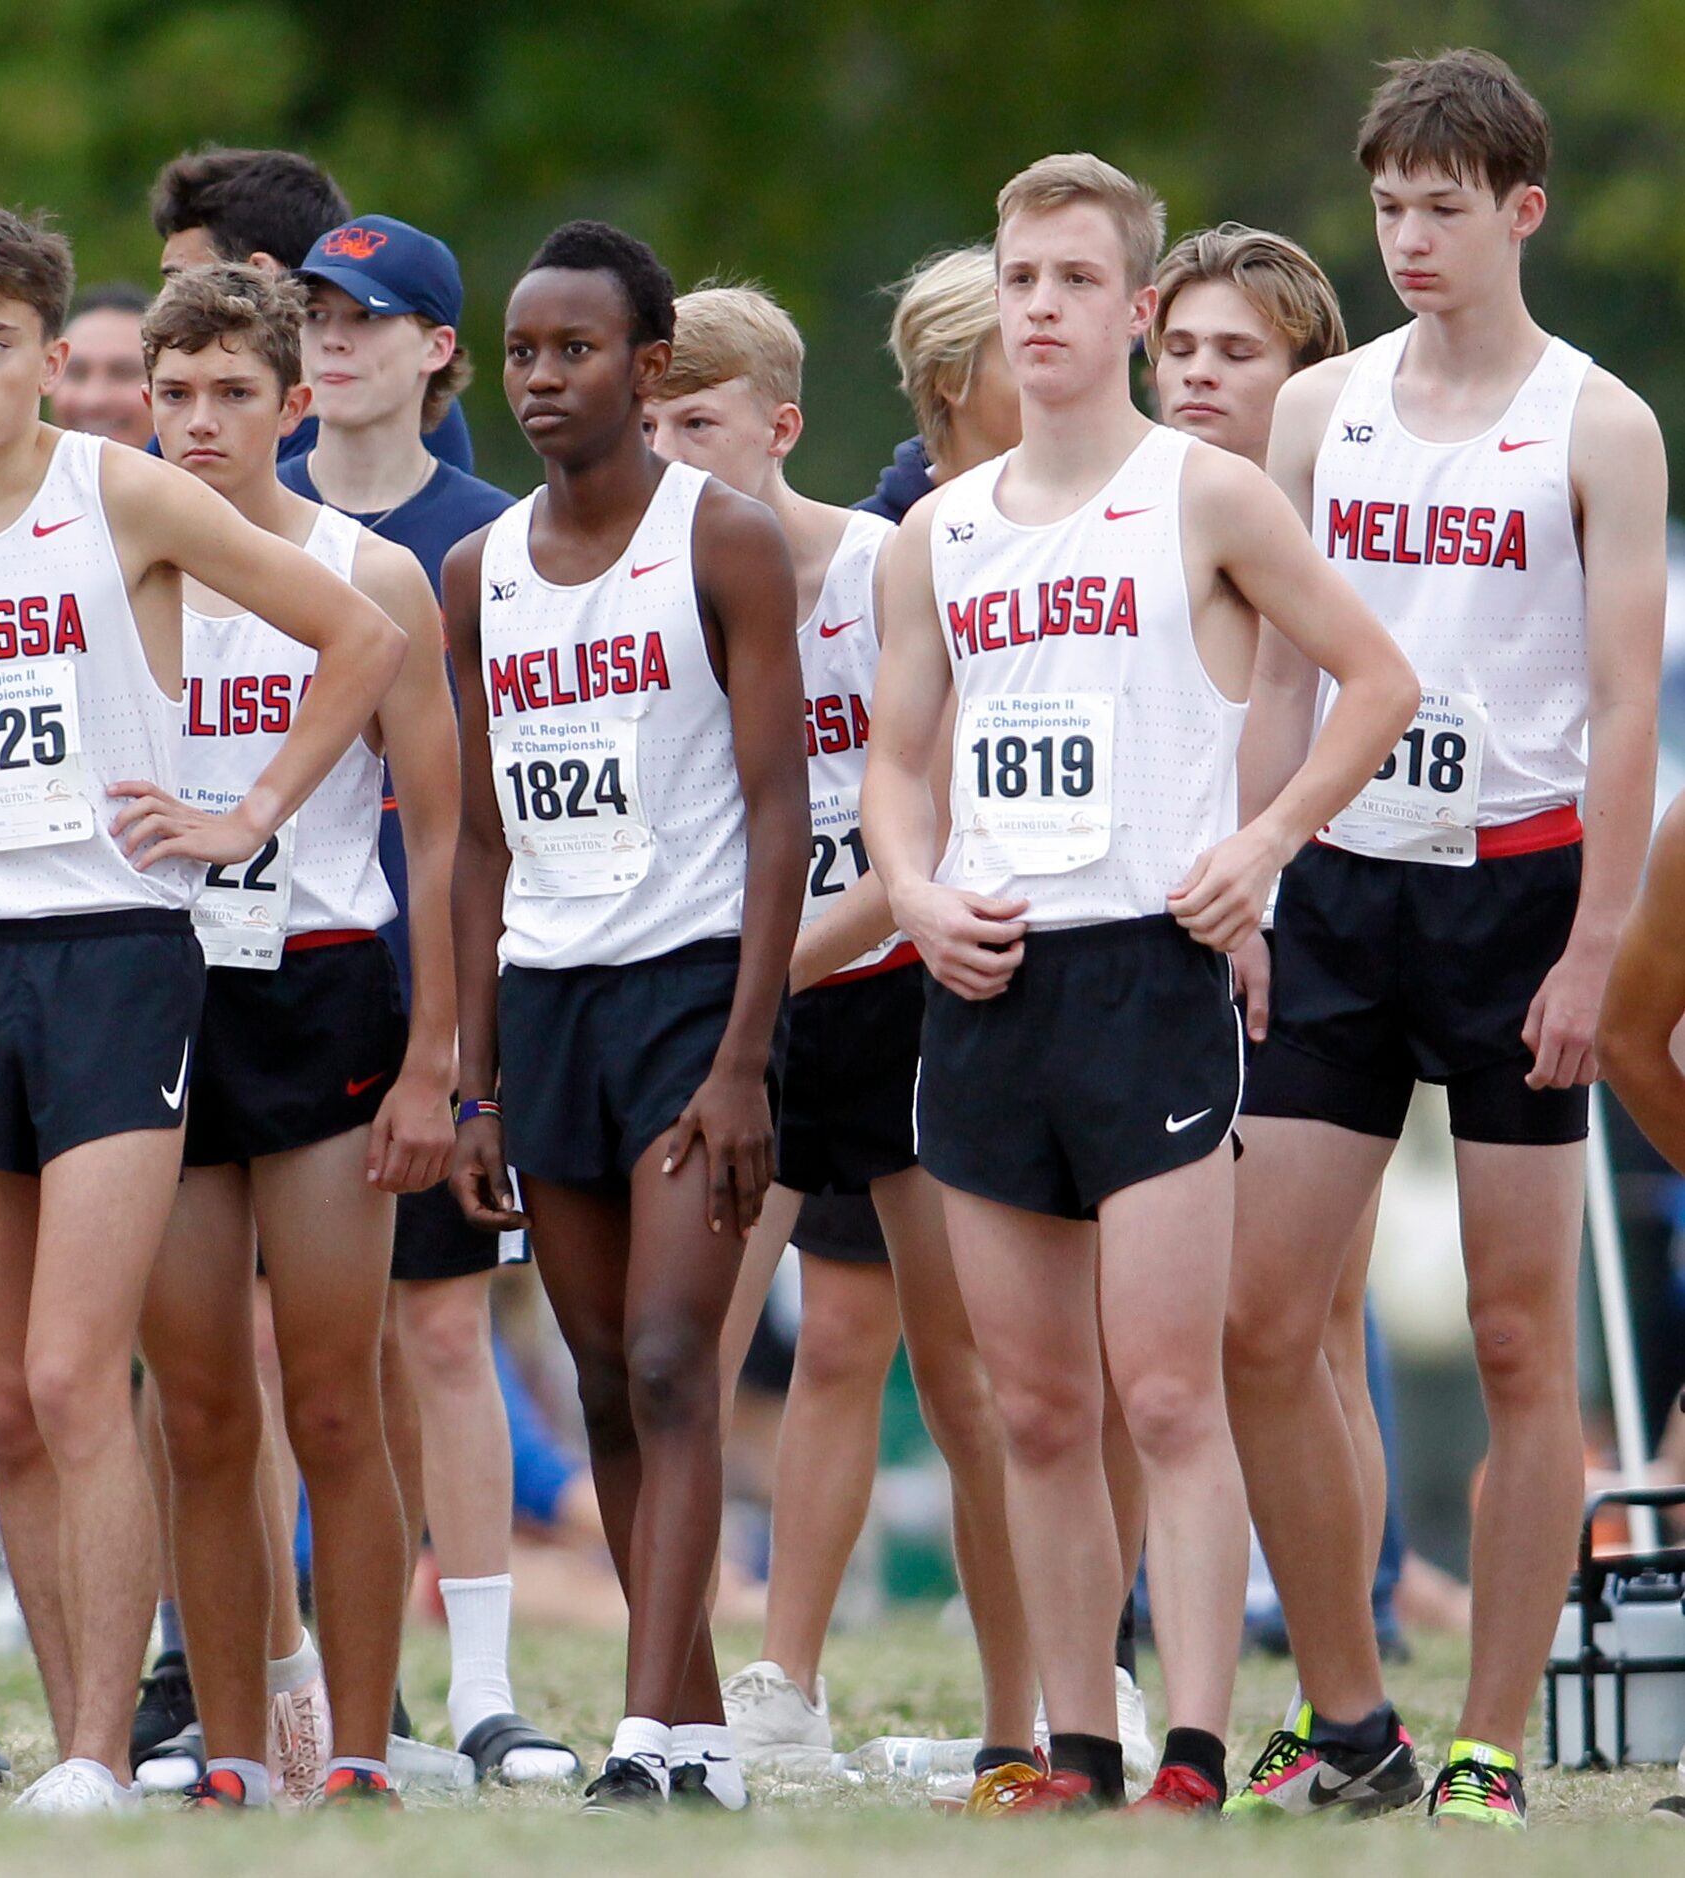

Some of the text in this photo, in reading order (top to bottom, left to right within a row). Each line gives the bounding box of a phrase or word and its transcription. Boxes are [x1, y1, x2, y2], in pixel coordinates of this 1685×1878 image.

[1327, 498, 1527, 571] MELISSA
[946, 575, 1139, 660] MELISSA
[489, 631, 671, 717] MELISSA
[988, 700, 1008, 711] UIL
[1012, 699, 1060, 712] Region
[519, 725, 536, 736] UIL
[540, 724, 587, 737] Region
[993, 716, 1090, 729] Championship
[524, 738, 616, 753] Championship
[971, 735, 1094, 798] 1819
[506, 757, 628, 821] 1824
[1361, 800, 1421, 820] ARLINGTON
[544, 840, 602, 852] ARLINGTON
